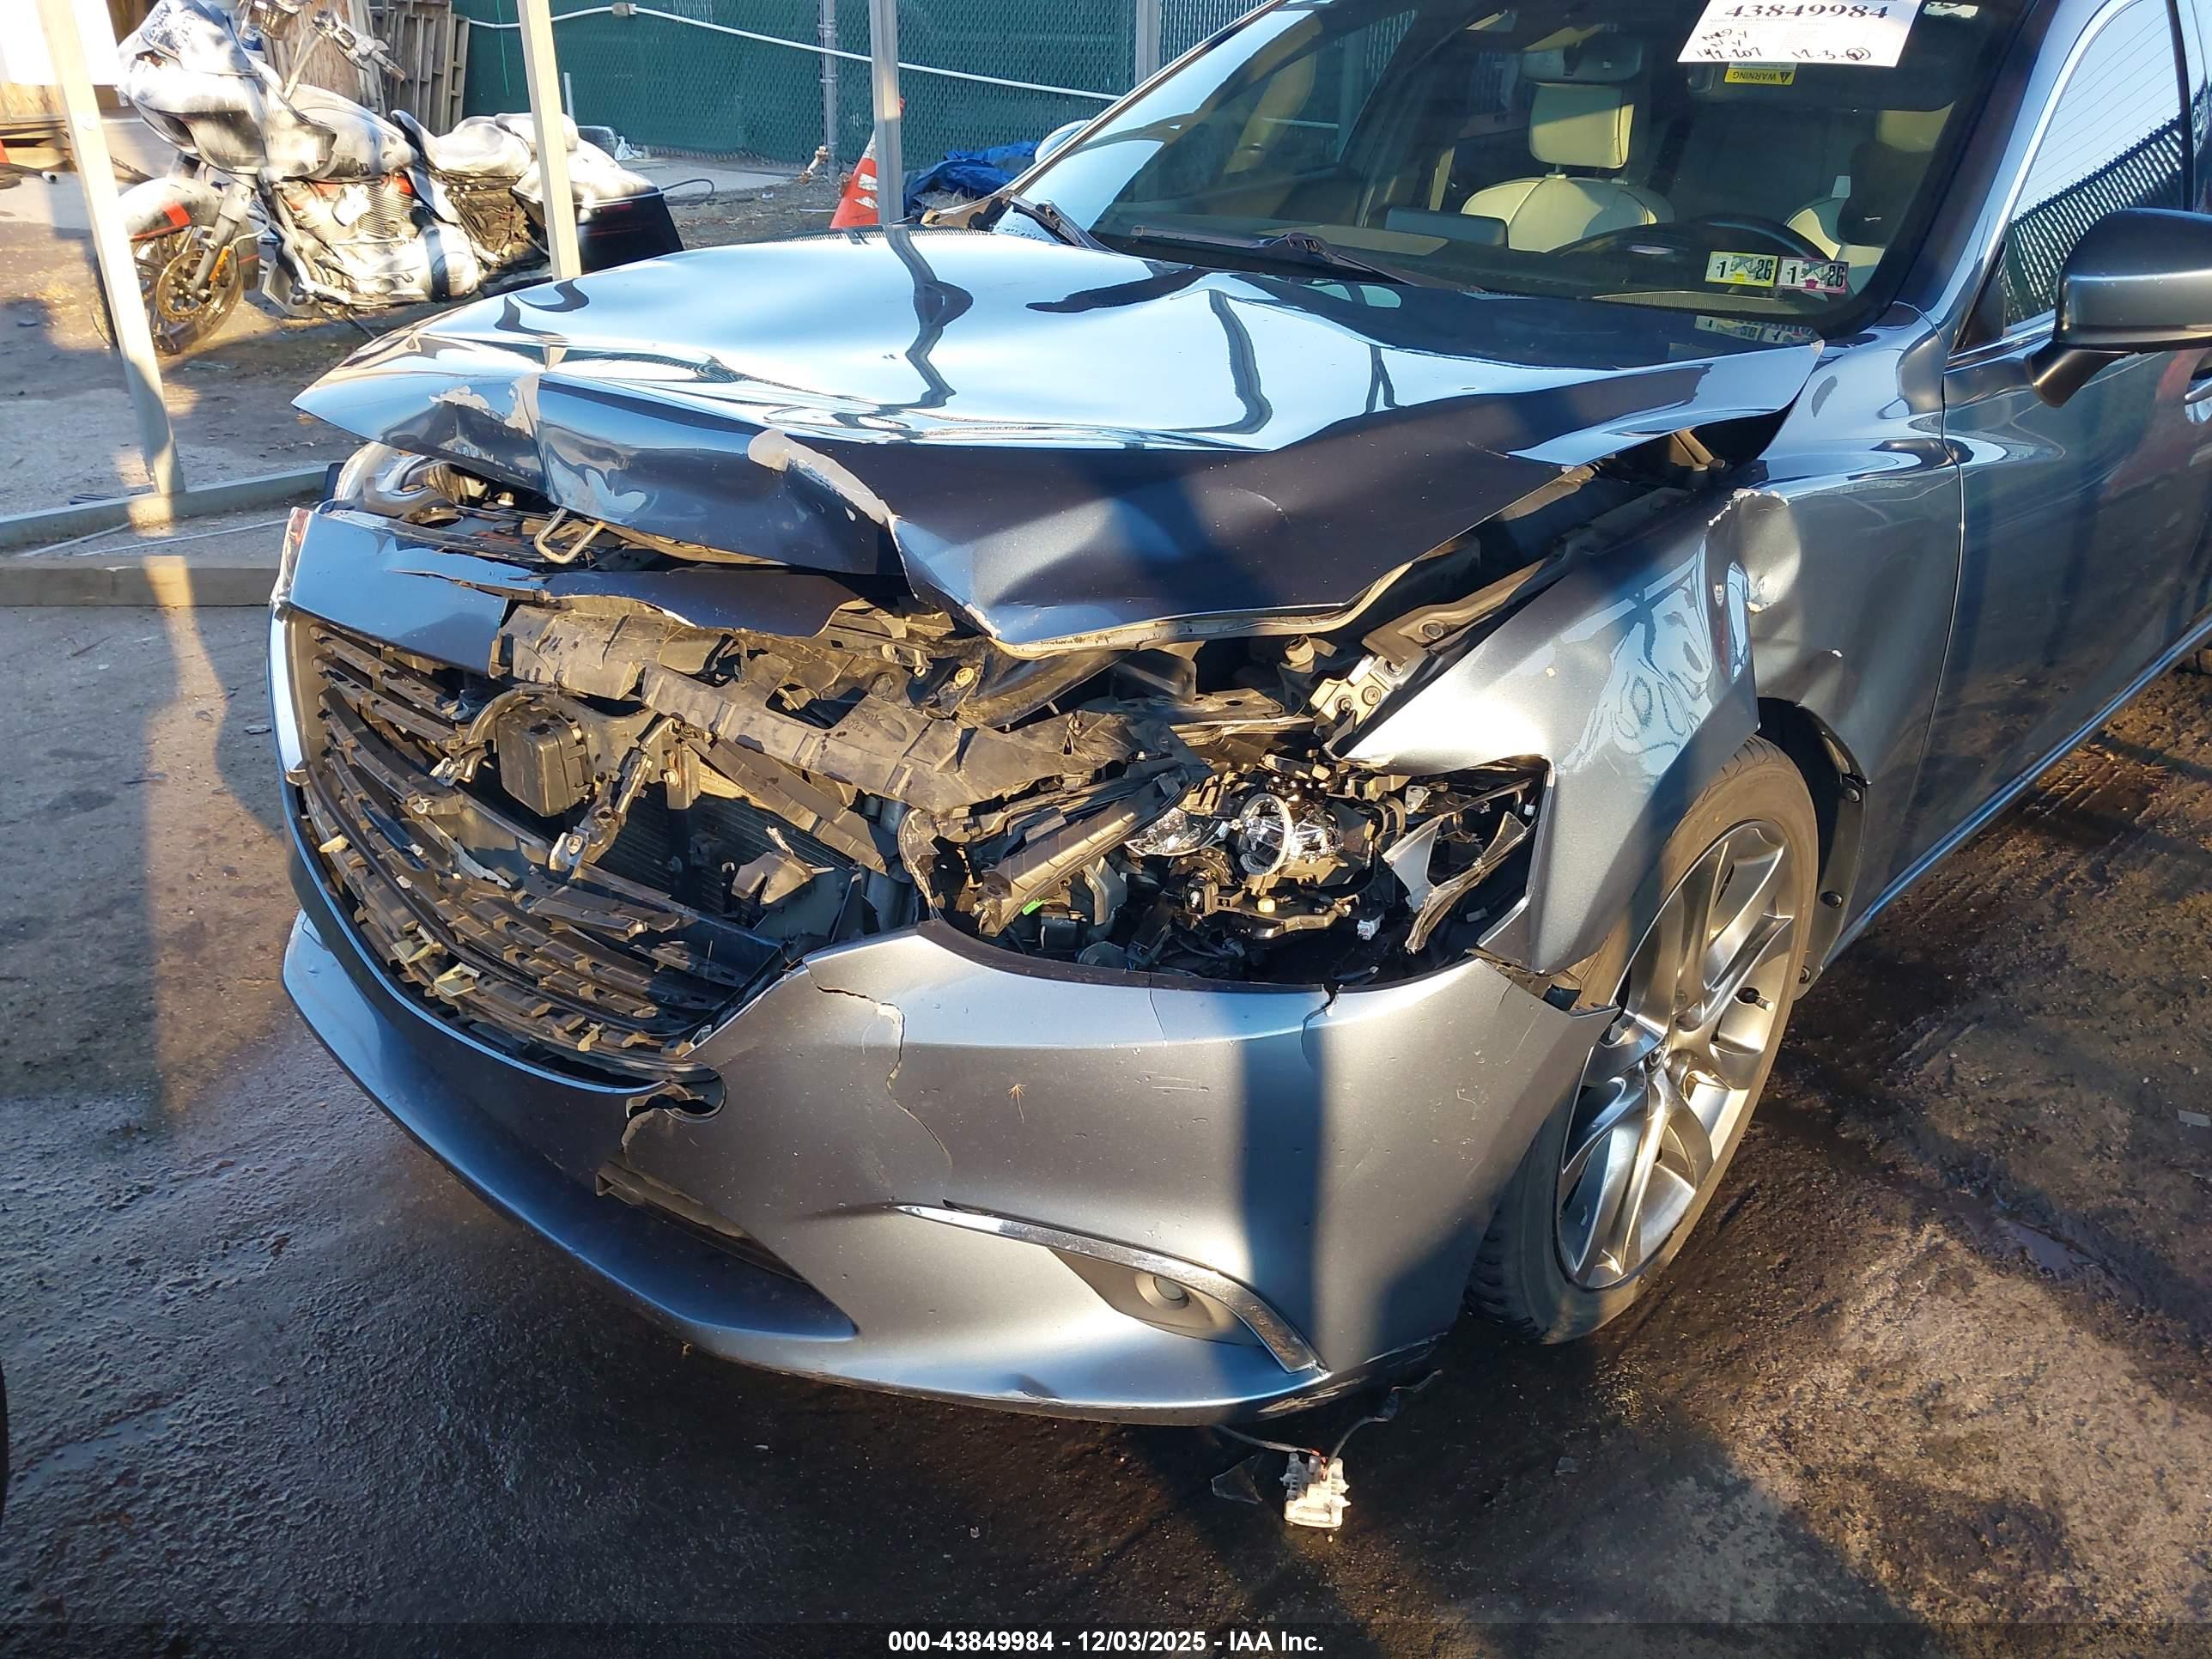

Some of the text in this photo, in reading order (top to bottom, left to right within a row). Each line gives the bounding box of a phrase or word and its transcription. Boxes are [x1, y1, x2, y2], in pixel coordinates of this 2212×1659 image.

[1725, 3, 1888, 20] 43849984
[1733, 71, 1776, 82] WARNING
[1755, 259, 1773, 281] 26
[1826, 264, 1844, 287] 26
